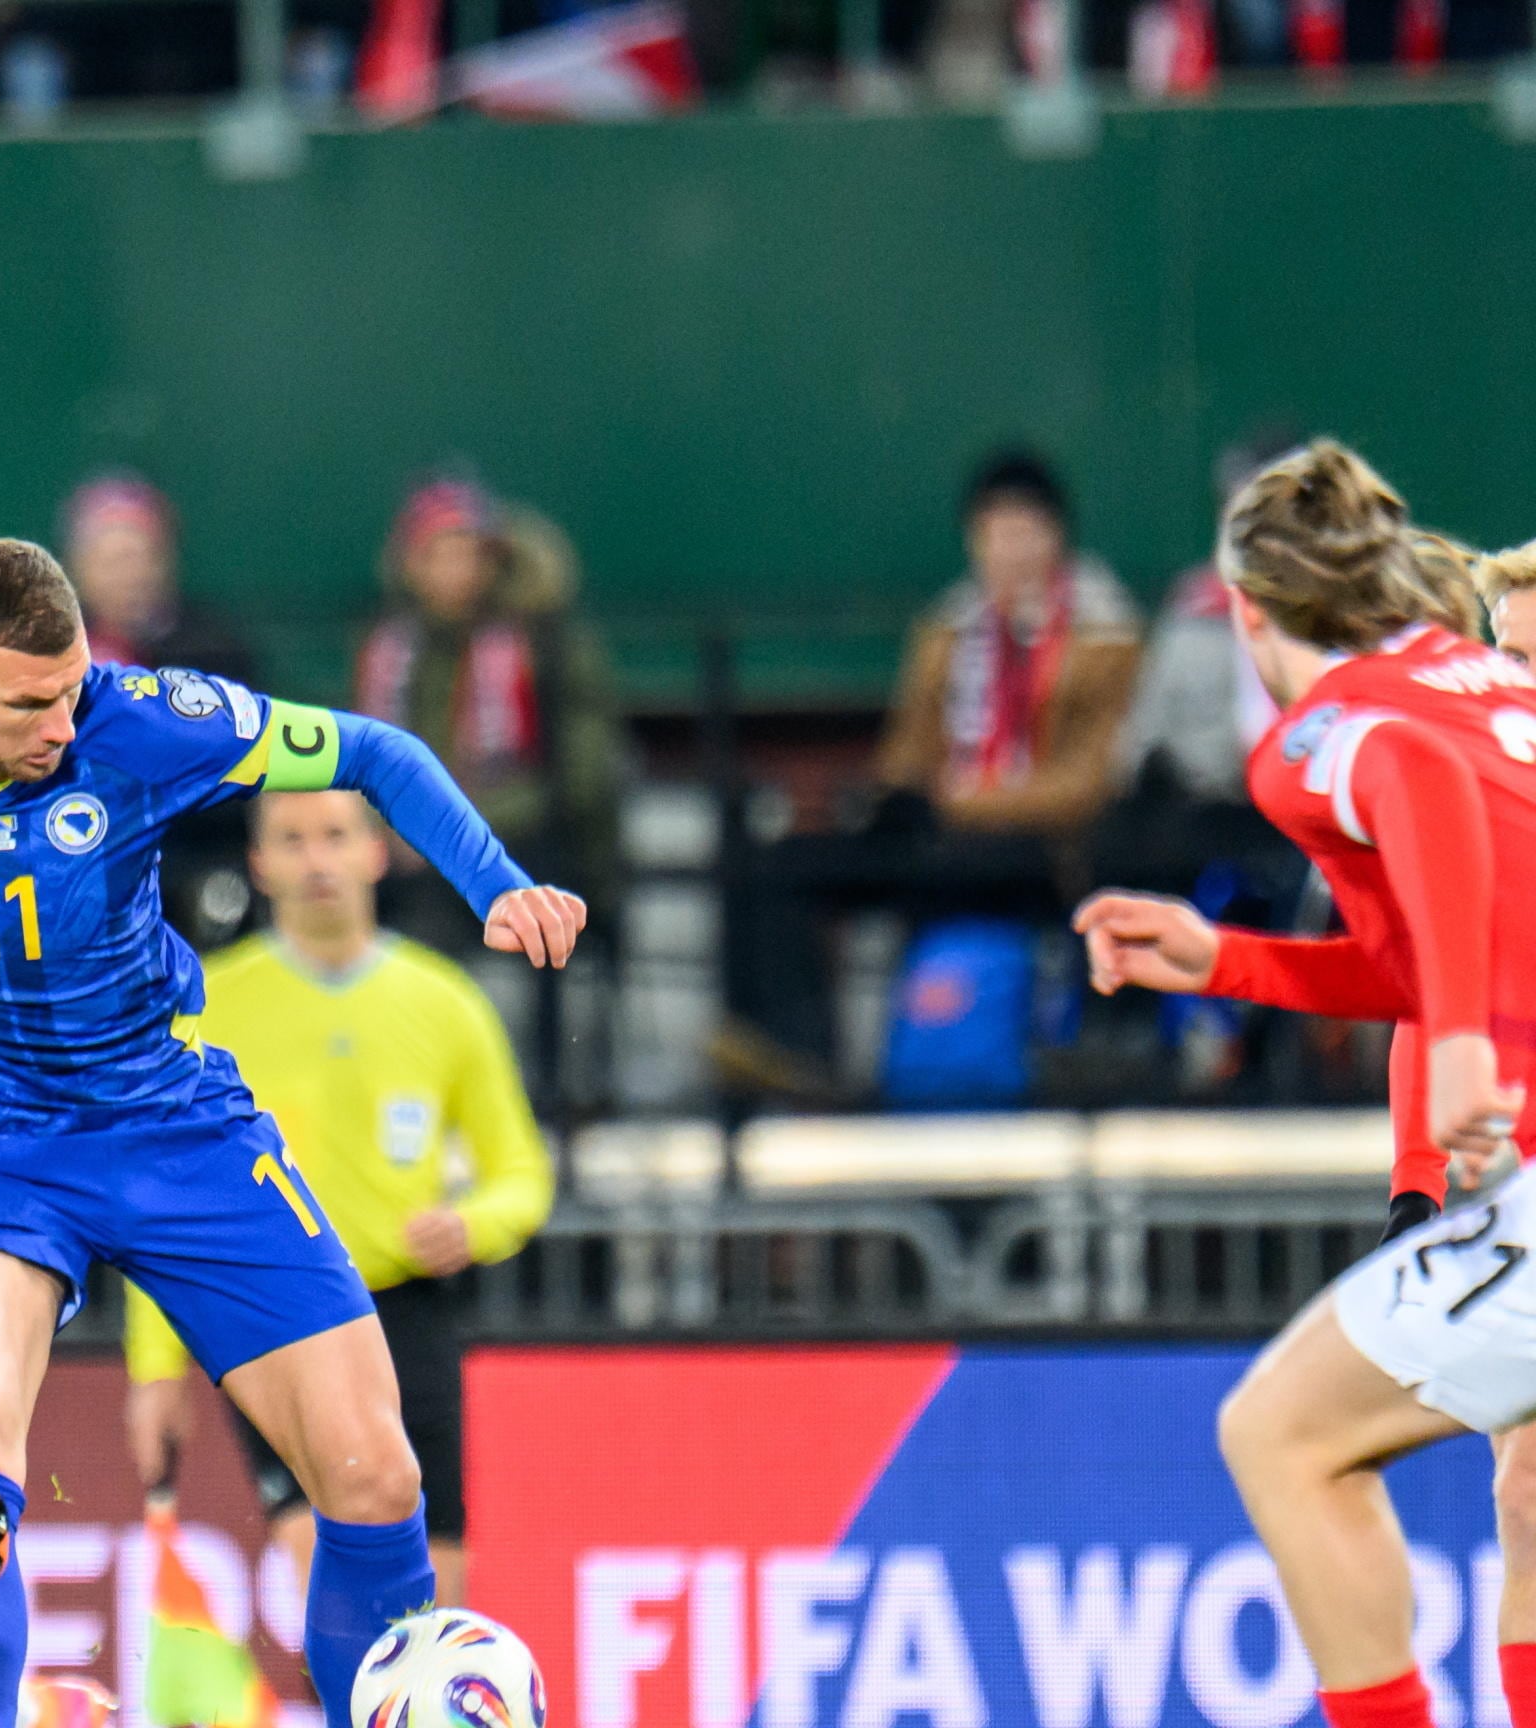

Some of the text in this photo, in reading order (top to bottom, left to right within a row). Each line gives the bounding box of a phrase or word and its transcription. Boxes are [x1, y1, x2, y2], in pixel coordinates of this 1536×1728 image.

[282, 724, 326, 758] C
[251, 1146, 321, 1238] 1
[1415, 1203, 1528, 1324] 21
[573, 1546, 991, 1728] FIFA
